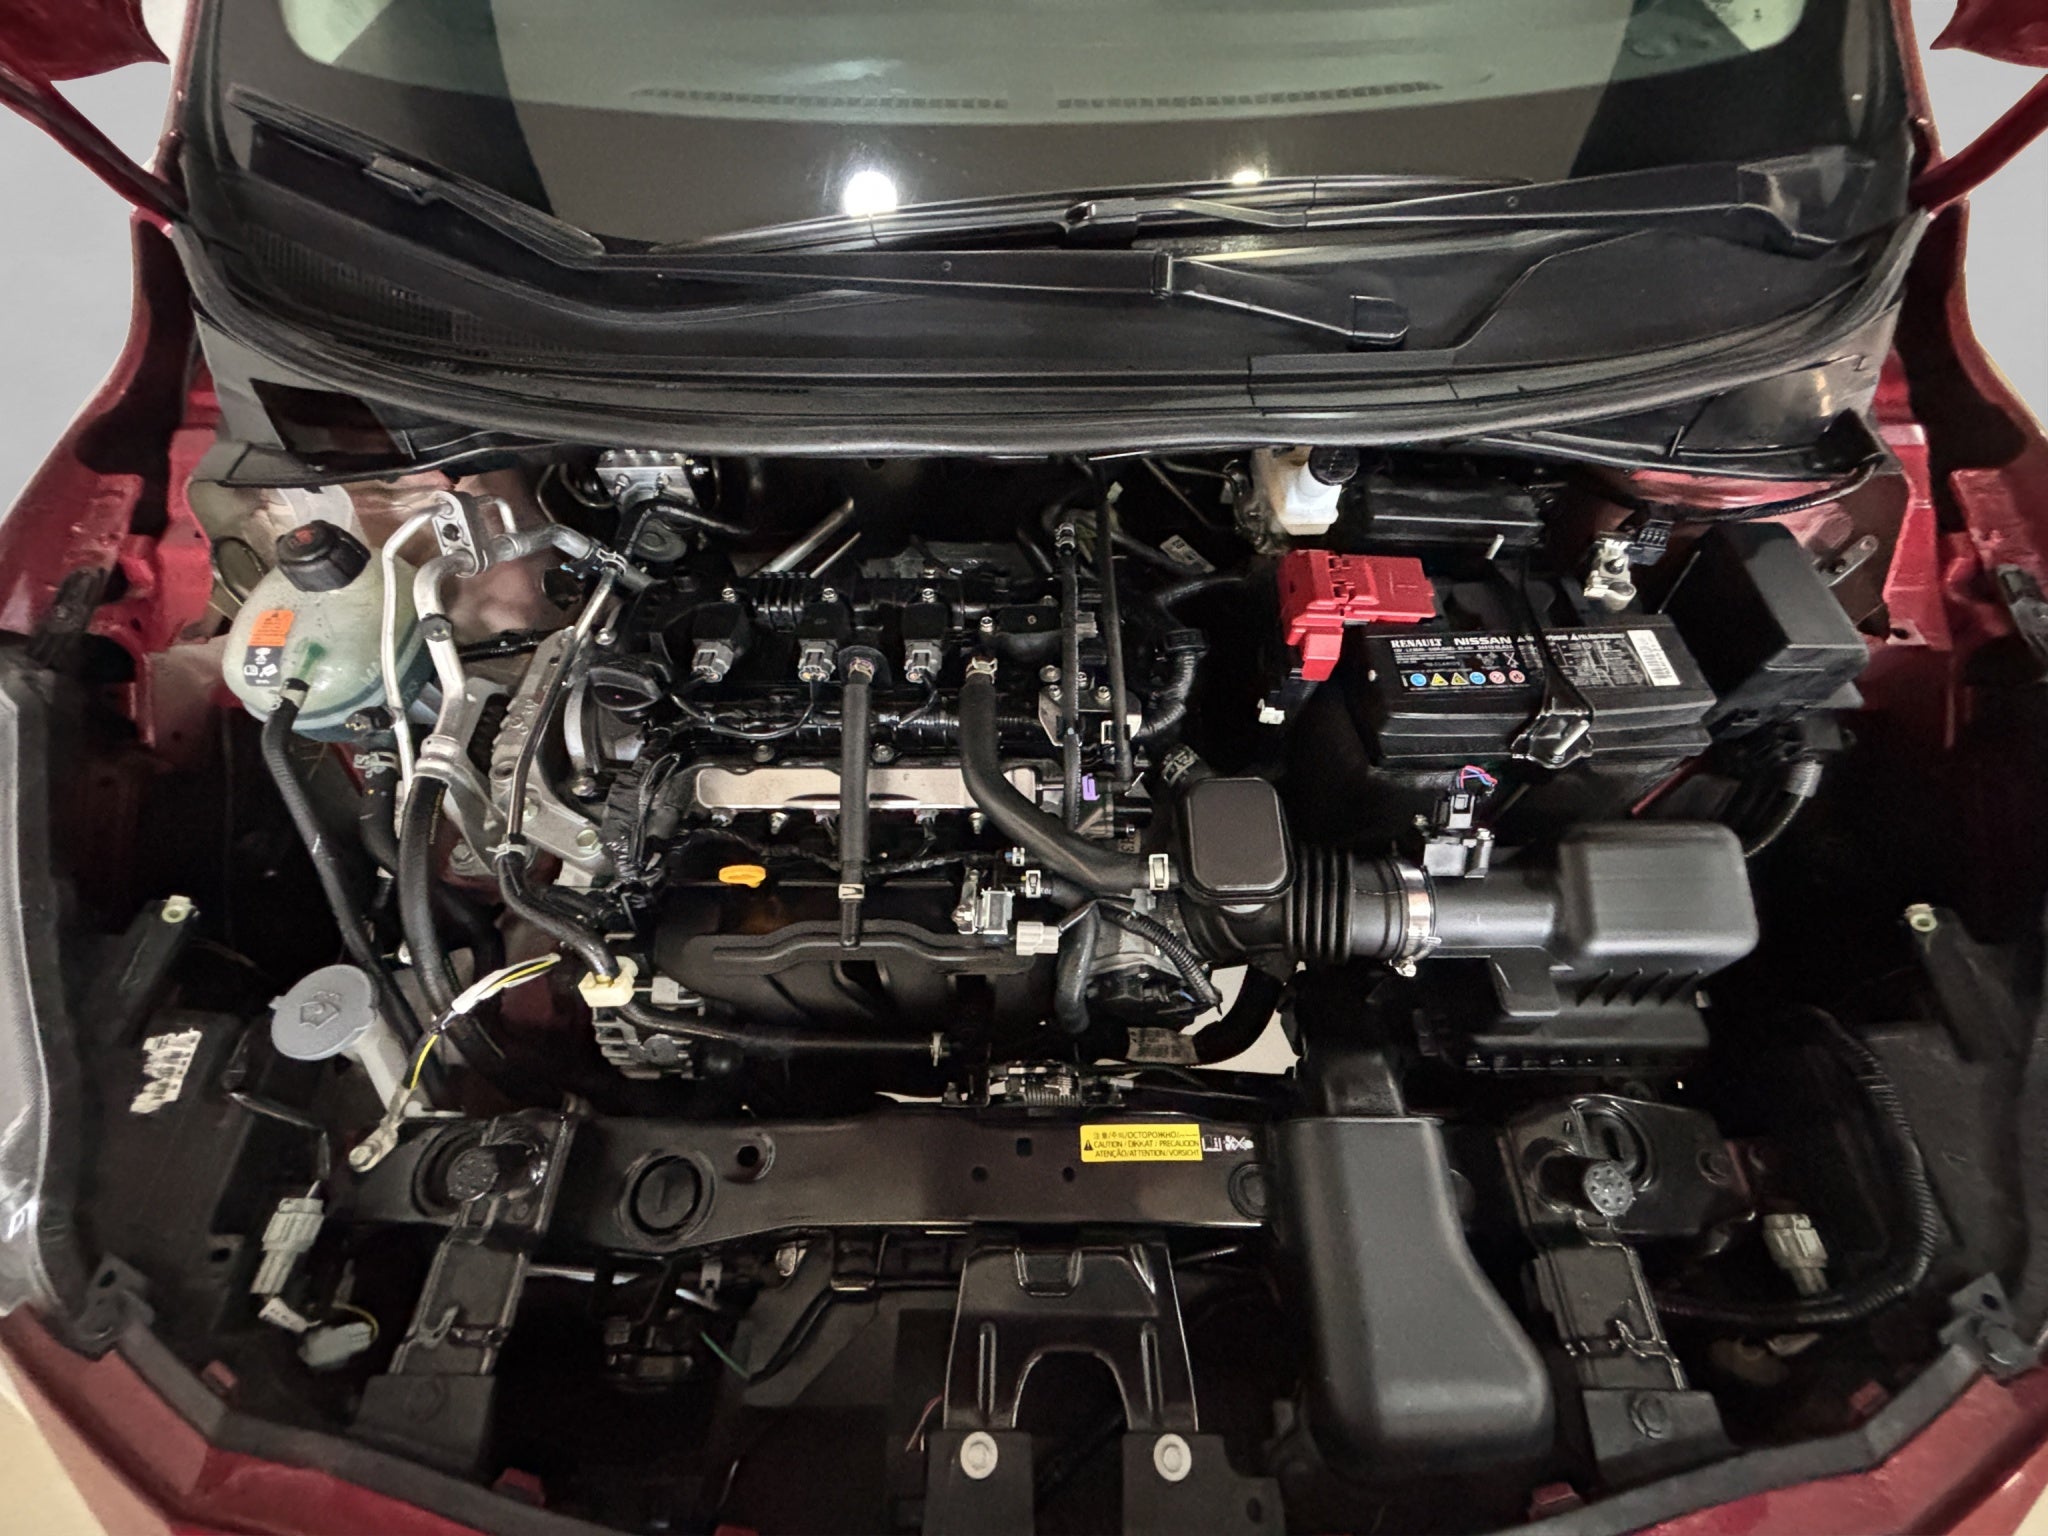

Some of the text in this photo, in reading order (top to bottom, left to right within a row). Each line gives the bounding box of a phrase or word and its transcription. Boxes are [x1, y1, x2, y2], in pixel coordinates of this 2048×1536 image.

[1390, 636, 1513, 648] RENAULT NISSAN
[1093, 1140, 1123, 1149] CAUTION
